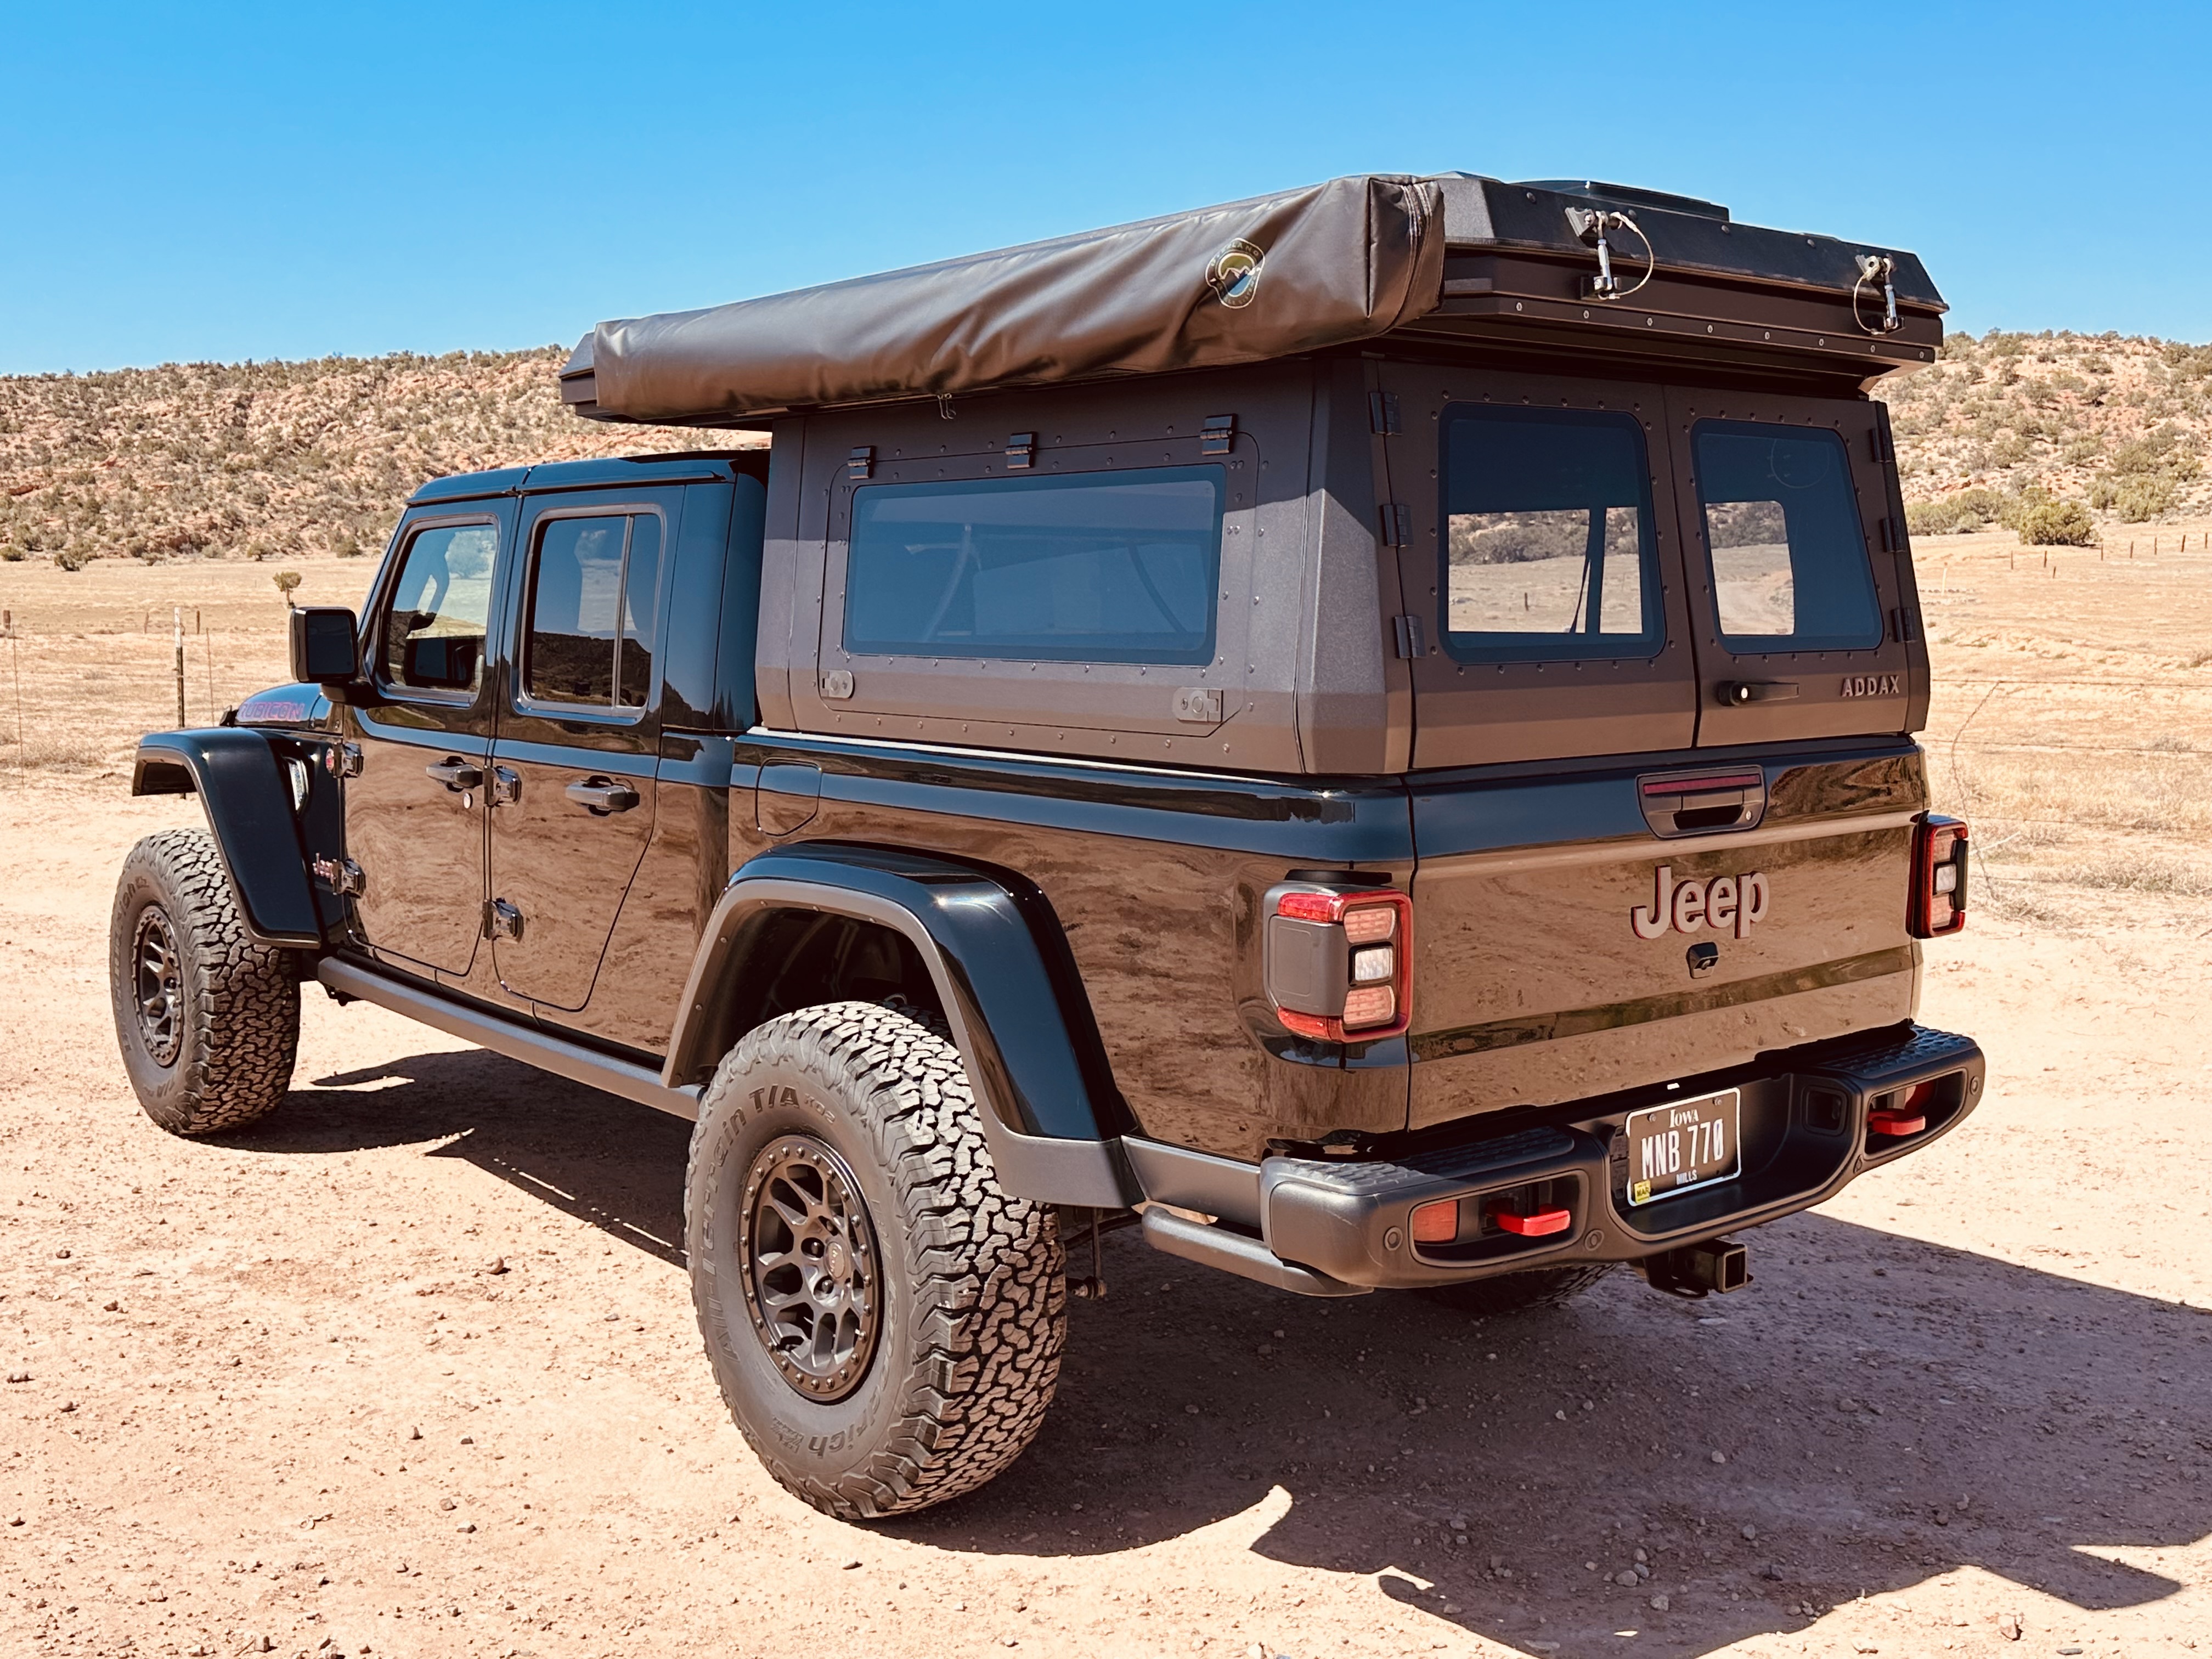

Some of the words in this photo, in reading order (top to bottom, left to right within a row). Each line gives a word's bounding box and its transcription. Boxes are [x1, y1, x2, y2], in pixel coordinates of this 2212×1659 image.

[1841, 675, 1899, 697] ADDAX
[312, 853, 334, 884] Jee
[1631, 865, 1769, 939] Jeep
[748, 1084, 800, 1114] T/A
[1641, 1130, 1680, 1180] MNB
[1687, 1118, 1724, 1168] 770
